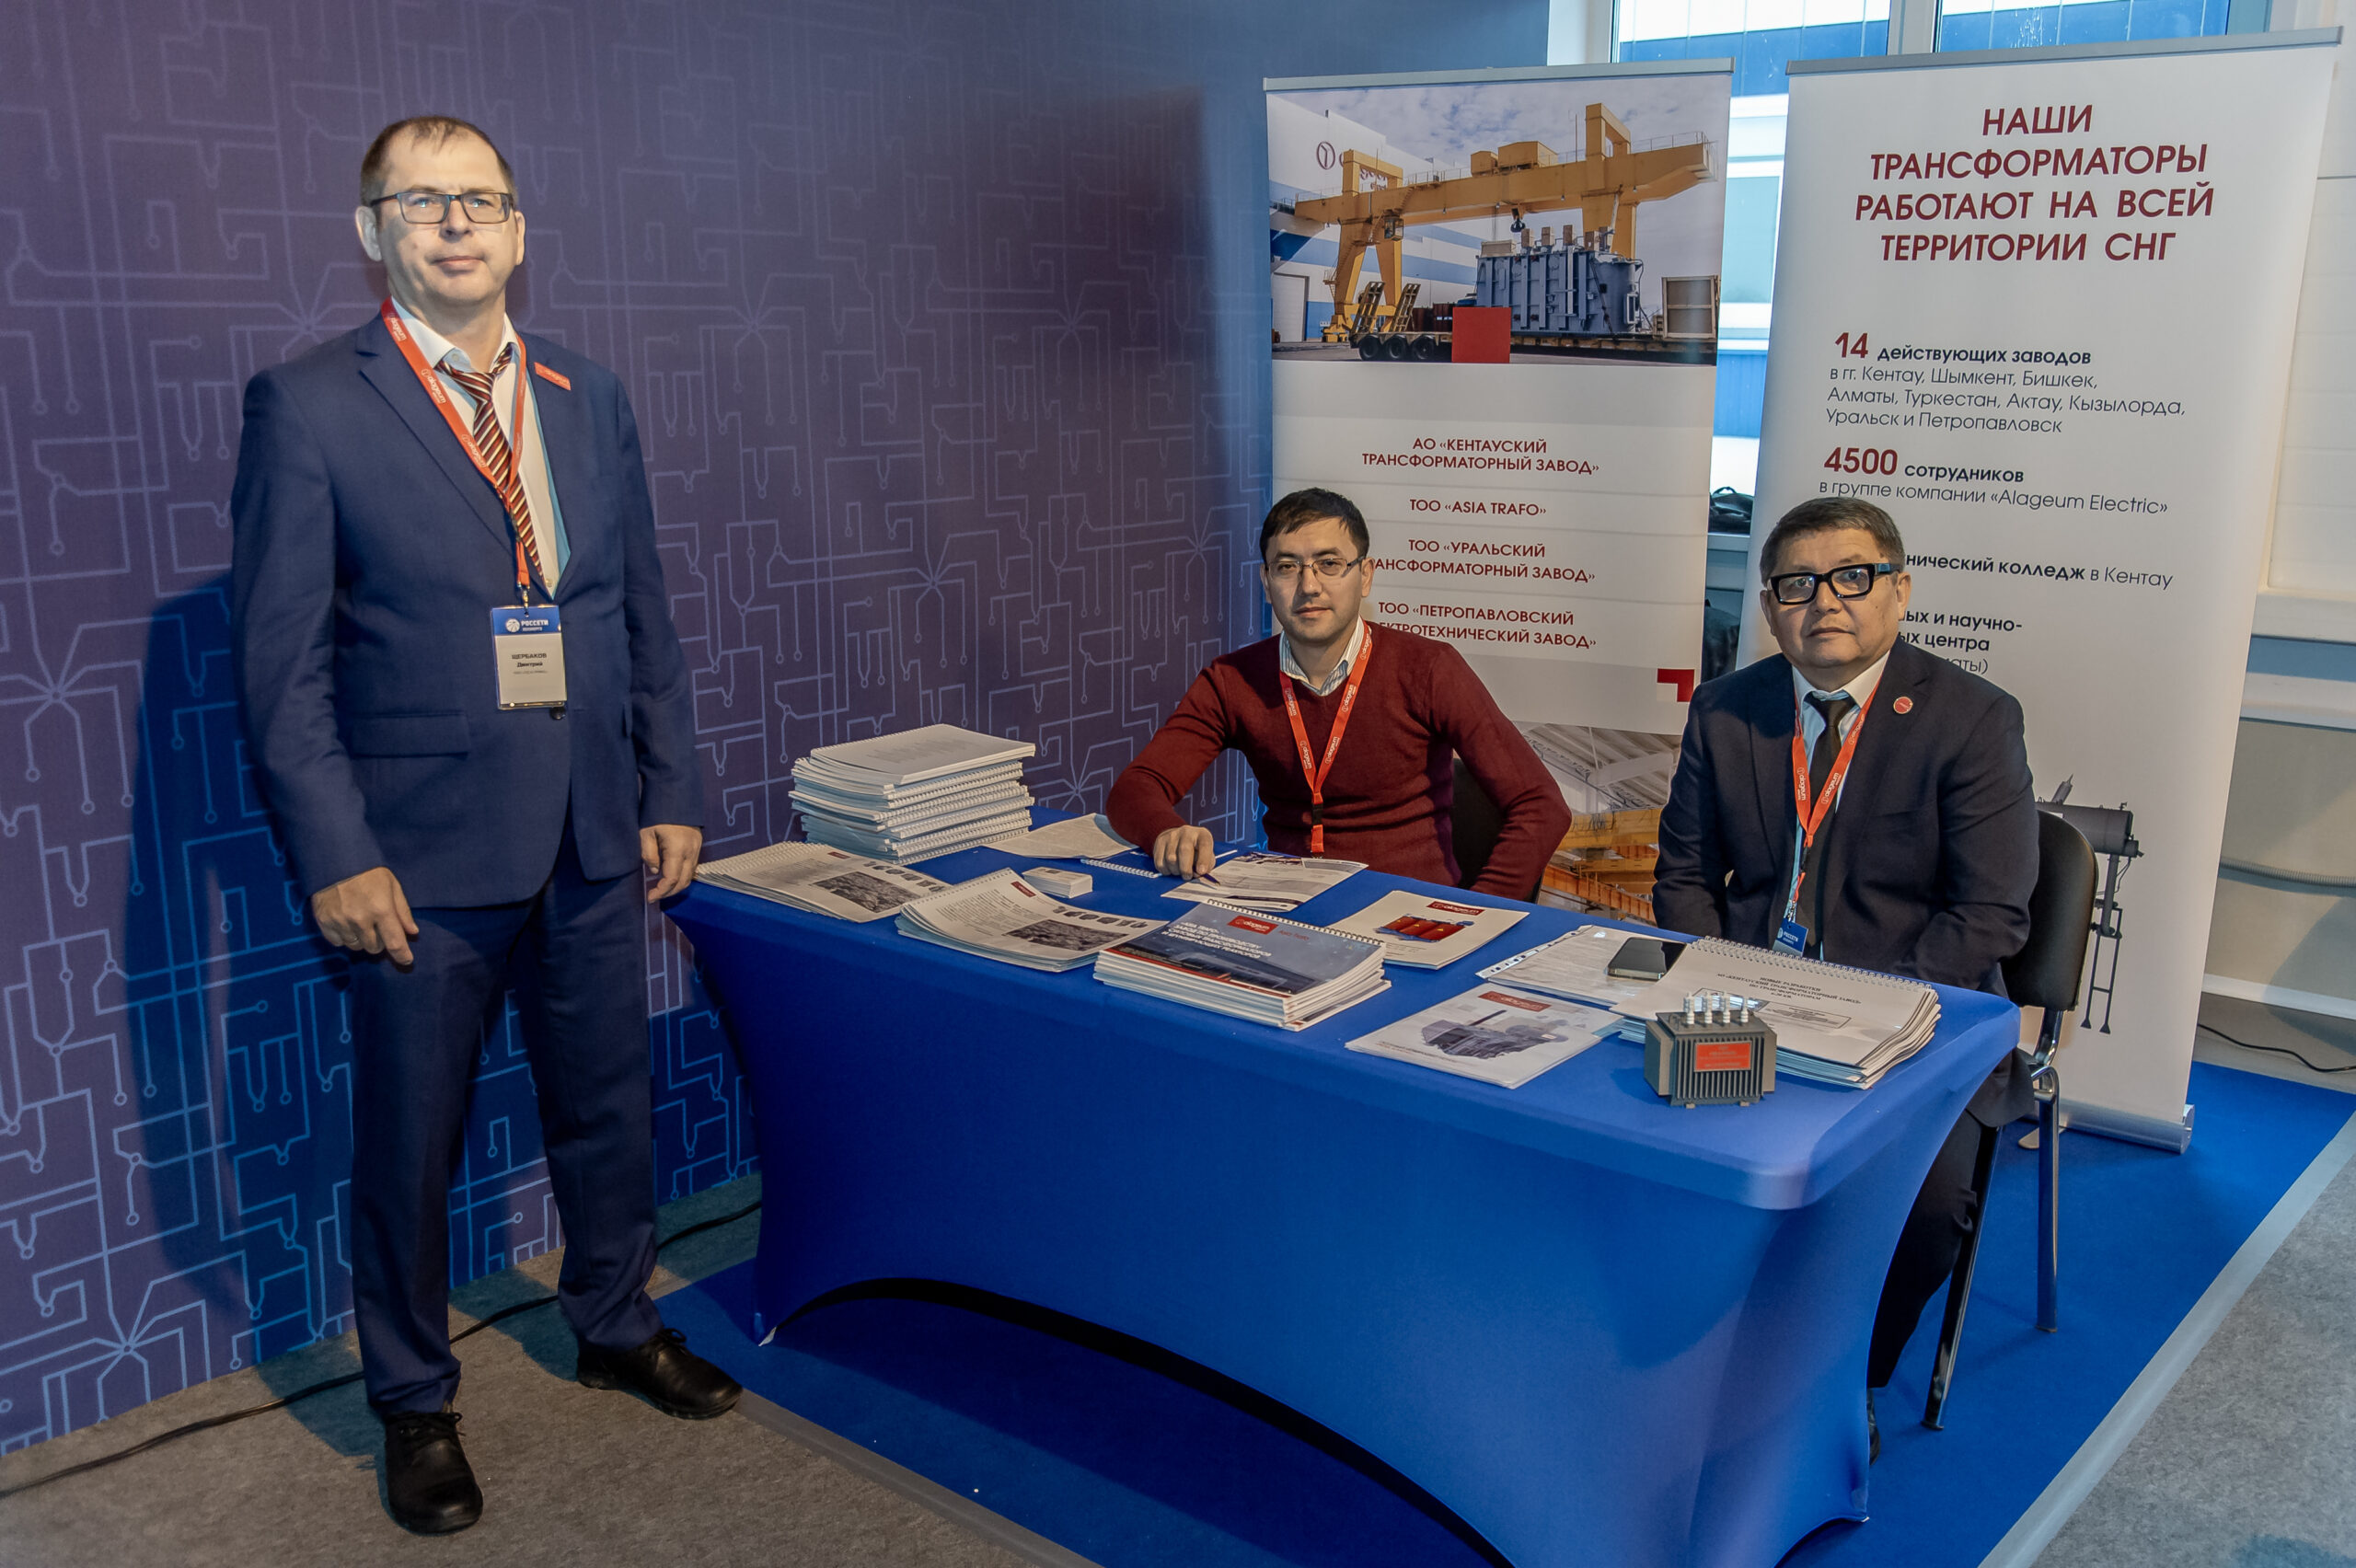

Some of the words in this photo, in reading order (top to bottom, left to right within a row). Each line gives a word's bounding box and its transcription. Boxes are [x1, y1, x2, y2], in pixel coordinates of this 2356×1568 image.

[1981, 103, 2093, 136] НАШИ
[1870, 143, 2208, 180] ТРАНСФОРМАТОРЫ
[1854, 190, 2035, 222] РАБОТАЮТ
[2049, 190, 2098, 219] НА
[2117, 180, 2215, 218] ВСЕЙ
[1880, 233, 2087, 262] ТЕРРИТОРИИ
[2104, 232, 2177, 261] СНГ
[1834, 331, 1869, 359] 14
[1877, 344, 2008, 365] действующих
[2011, 350, 2092, 367] заводов
[1830, 368, 1839, 380] в
[1842, 368, 1856, 381] гг.
[1862, 365, 1925, 386] Кентау,
[1931, 367, 2016, 387] Шымкент,
[2022, 370, 2097, 390] Бишкек,
[1827, 386, 1899, 406] Алматы,
[1904, 388, 2001, 409] Туркестан,
[2005, 392, 2063, 414] Актау,
[2069, 394, 2186, 417] Кызылорда,
[1826, 408, 1900, 427] Уральск
[1903, 414, 1915, 427] и
[1918, 411, 2062, 433] Петропавловск
[1412, 437, 1437, 451] АО
[1439, 438, 1547, 454] «КЕНТАУСКИЙ
[1361, 453, 1532, 471] ТРАНСФОРМАТОРНЫЙ
[1535, 458, 1600, 476] ЗАВОД»
[1823, 446, 1899, 476] 4500
[1904, 465, 2025, 483] сотрудников
[1409, 498, 1441, 513] ТОО
[1444, 501, 1487, 514] «ASIA
[1490, 502, 1547, 516] TRAFO»
[1819, 481, 1828, 493] в
[1831, 482, 1892, 499] группе
[1896, 486, 1986, 503] компании
[1990, 489, 2085, 511] «Alageum
[2089, 494, 2168, 514] Electric»
[1407, 538, 1440, 553] ТОО
[1443, 541, 1546, 559] «УРАЛЬСКИЙ
[1375, 559, 1529, 577] АНСФОРМАТОРНЫЙ
[1531, 566, 1596, 583] ЗАВОД»
[1905, 554, 1994, 573] нический
[1998, 561, 2086, 582] колледж
[2089, 569, 2099, 582] в
[2104, 566, 2174, 591] Кентау
[1378, 601, 1410, 616] ТОО
[1412, 604, 1574, 626] «ПЕТРОПАВЛОВСКИЙ
[1900, 611, 1929, 623] ых
[1933, 613, 1946, 626] и
[1948, 614, 2023, 632] научно-
[1533, 631, 1597, 650] ЗАВОД»
[1899, 631, 1920, 643] ых
[1924, 633, 1991, 653] центра
[1243, 920, 1270, 930] alageum
